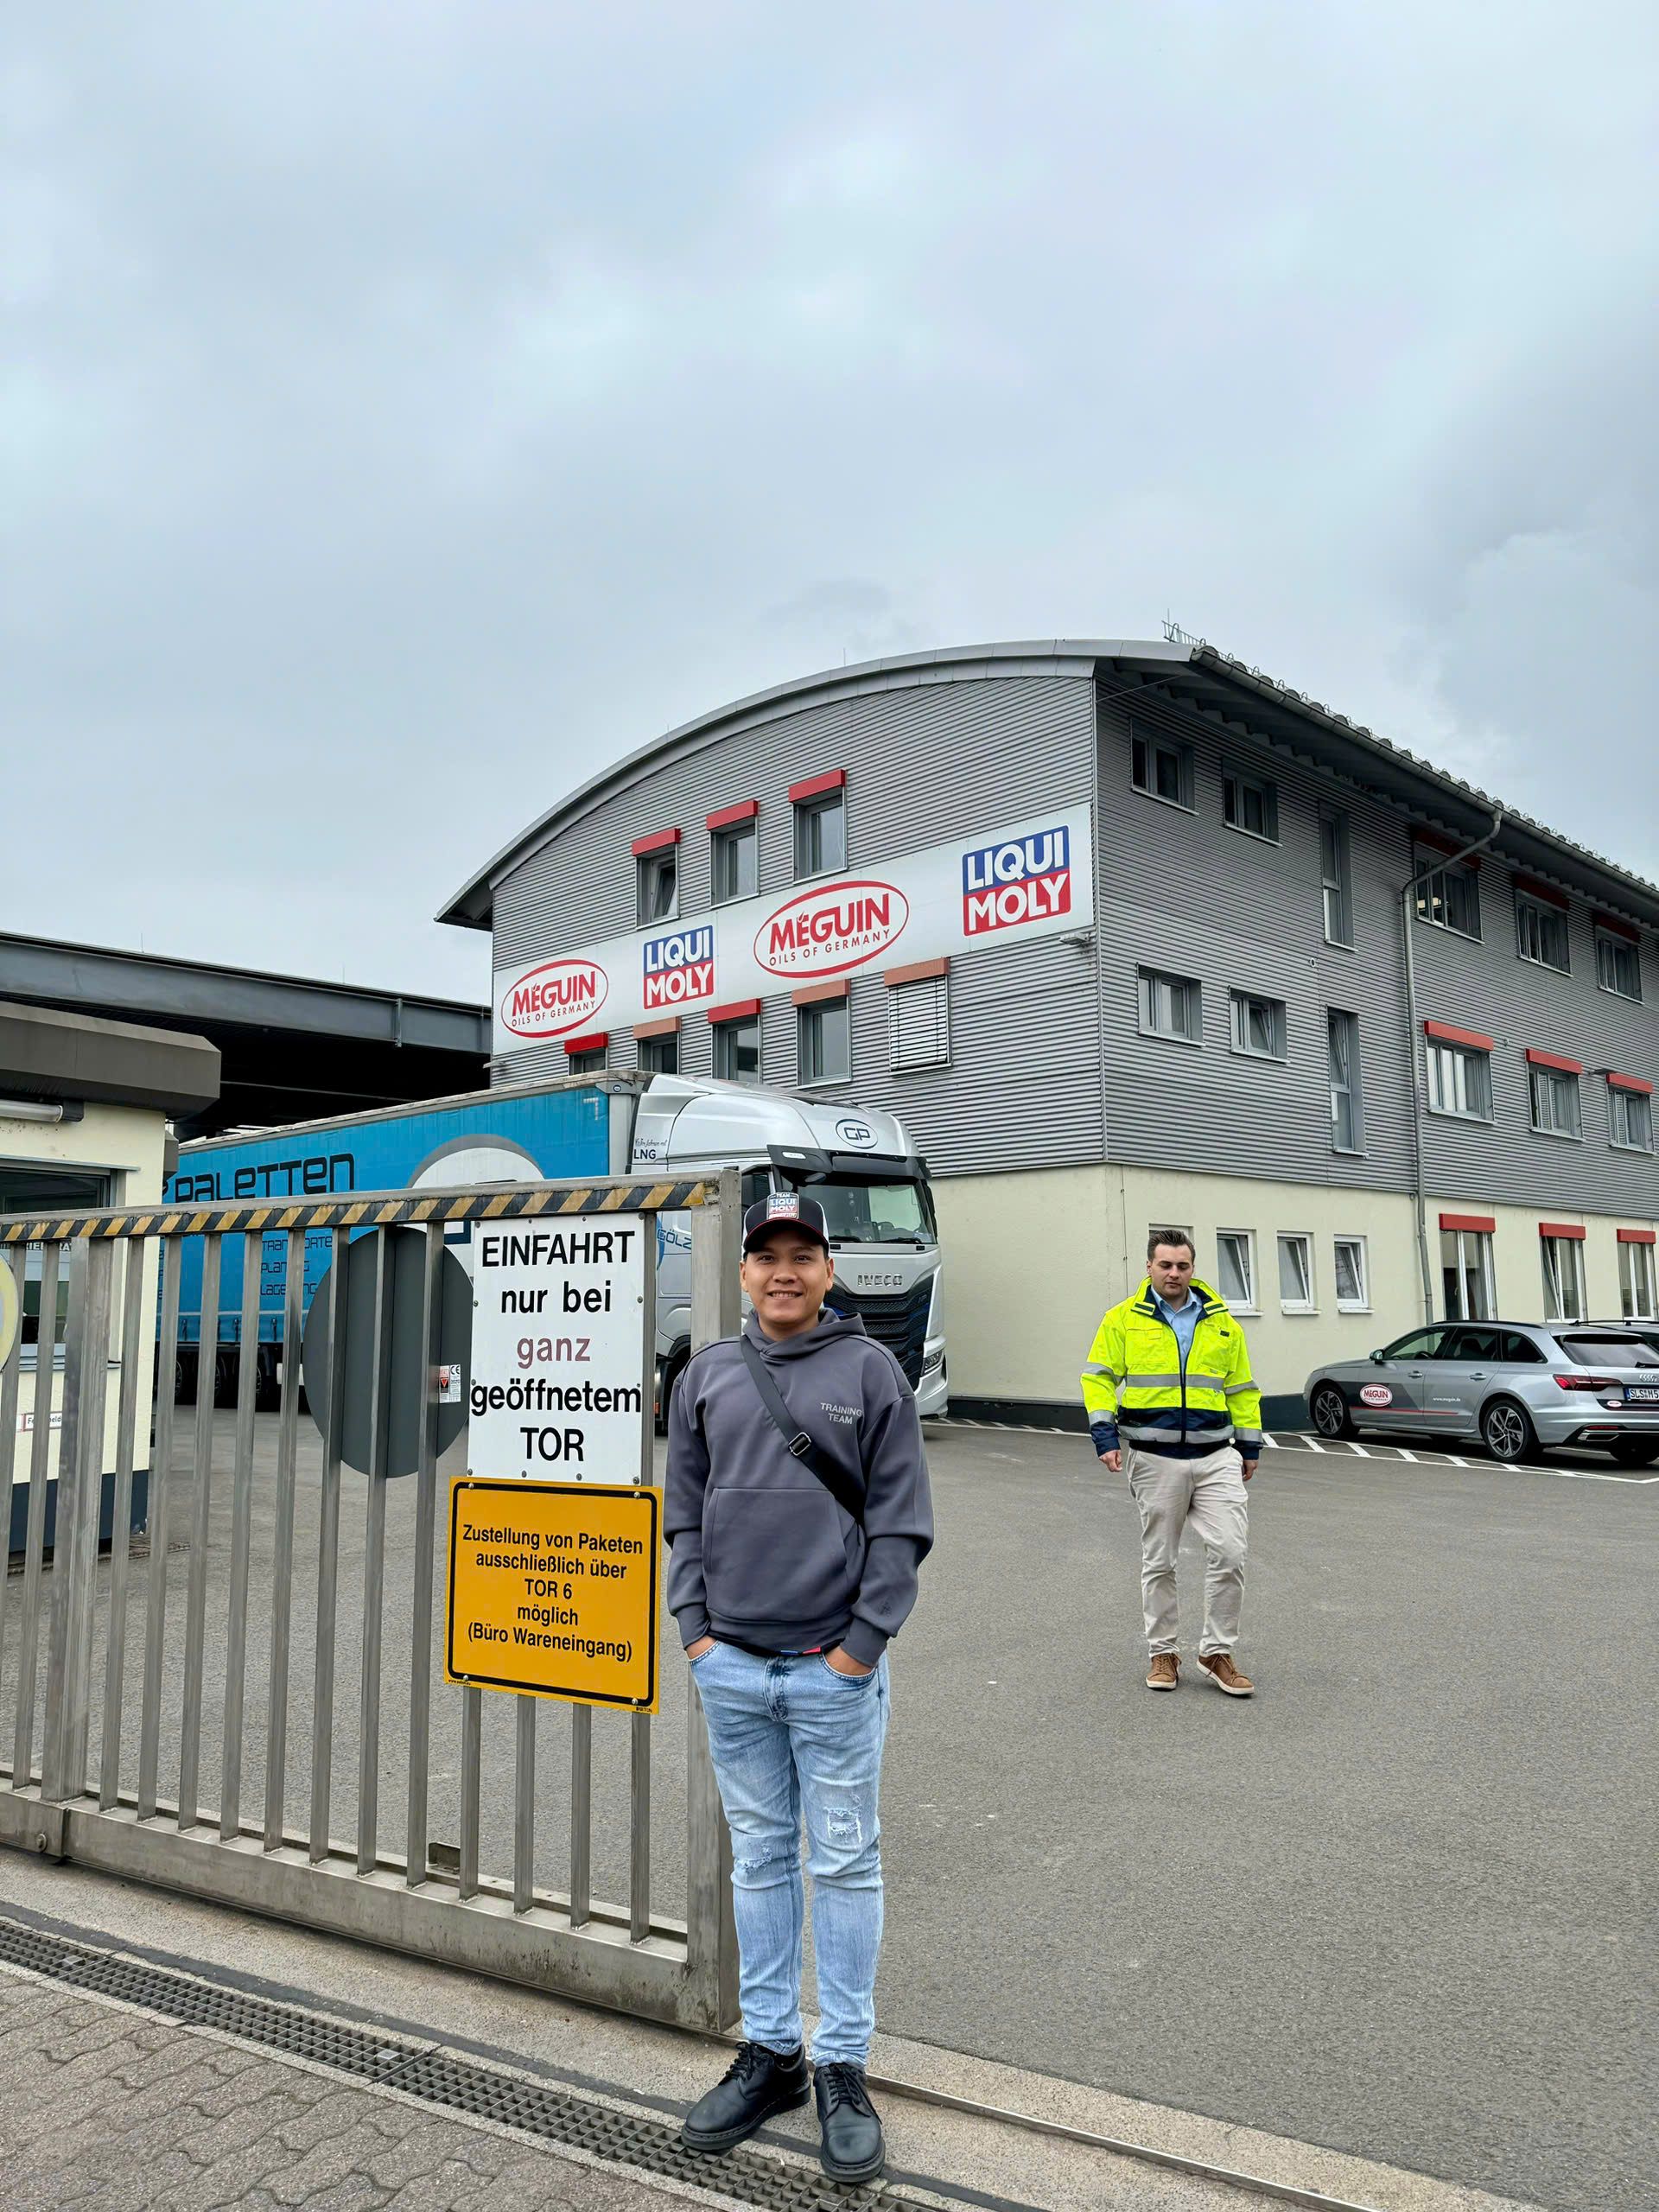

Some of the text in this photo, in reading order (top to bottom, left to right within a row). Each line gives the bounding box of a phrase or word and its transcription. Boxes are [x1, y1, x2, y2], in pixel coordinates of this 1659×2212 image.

[968, 830, 1064, 891] LIQUI
[969, 873, 1068, 931] MOLY
[646, 929, 709, 972] LIQUI
[769, 929, 891, 966] OILS OF GERMANY
[647, 963, 712, 1006] MOLY
[512, 1001, 595, 1027] OILS OF GERMANY
[633, 1148, 657, 1160] LNG
[481, 1230, 635, 1267] EINFAHRT
[857, 1274, 903, 1287] IVECO
[501, 1280, 611, 1313] nur bei
[517, 1338, 591, 1369] ganz
[471, 1378, 641, 1417] geöffnetem
[1630, 1389, 1644, 1398] SLS
[821, 1402, 862, 1417] TRAINING
[829, 1413, 853, 1424] TEAM
[520, 1427, 584, 1461] TOR
[462, 1524, 643, 1554] Zustellung von Paketen
[476, 1553, 626, 1578] ausschließlich über
[524, 1579, 572, 1599] TOR 6
[518, 1604, 579, 1627] möglich
[467, 1622, 632, 1662] (Büro Wareneingang)
